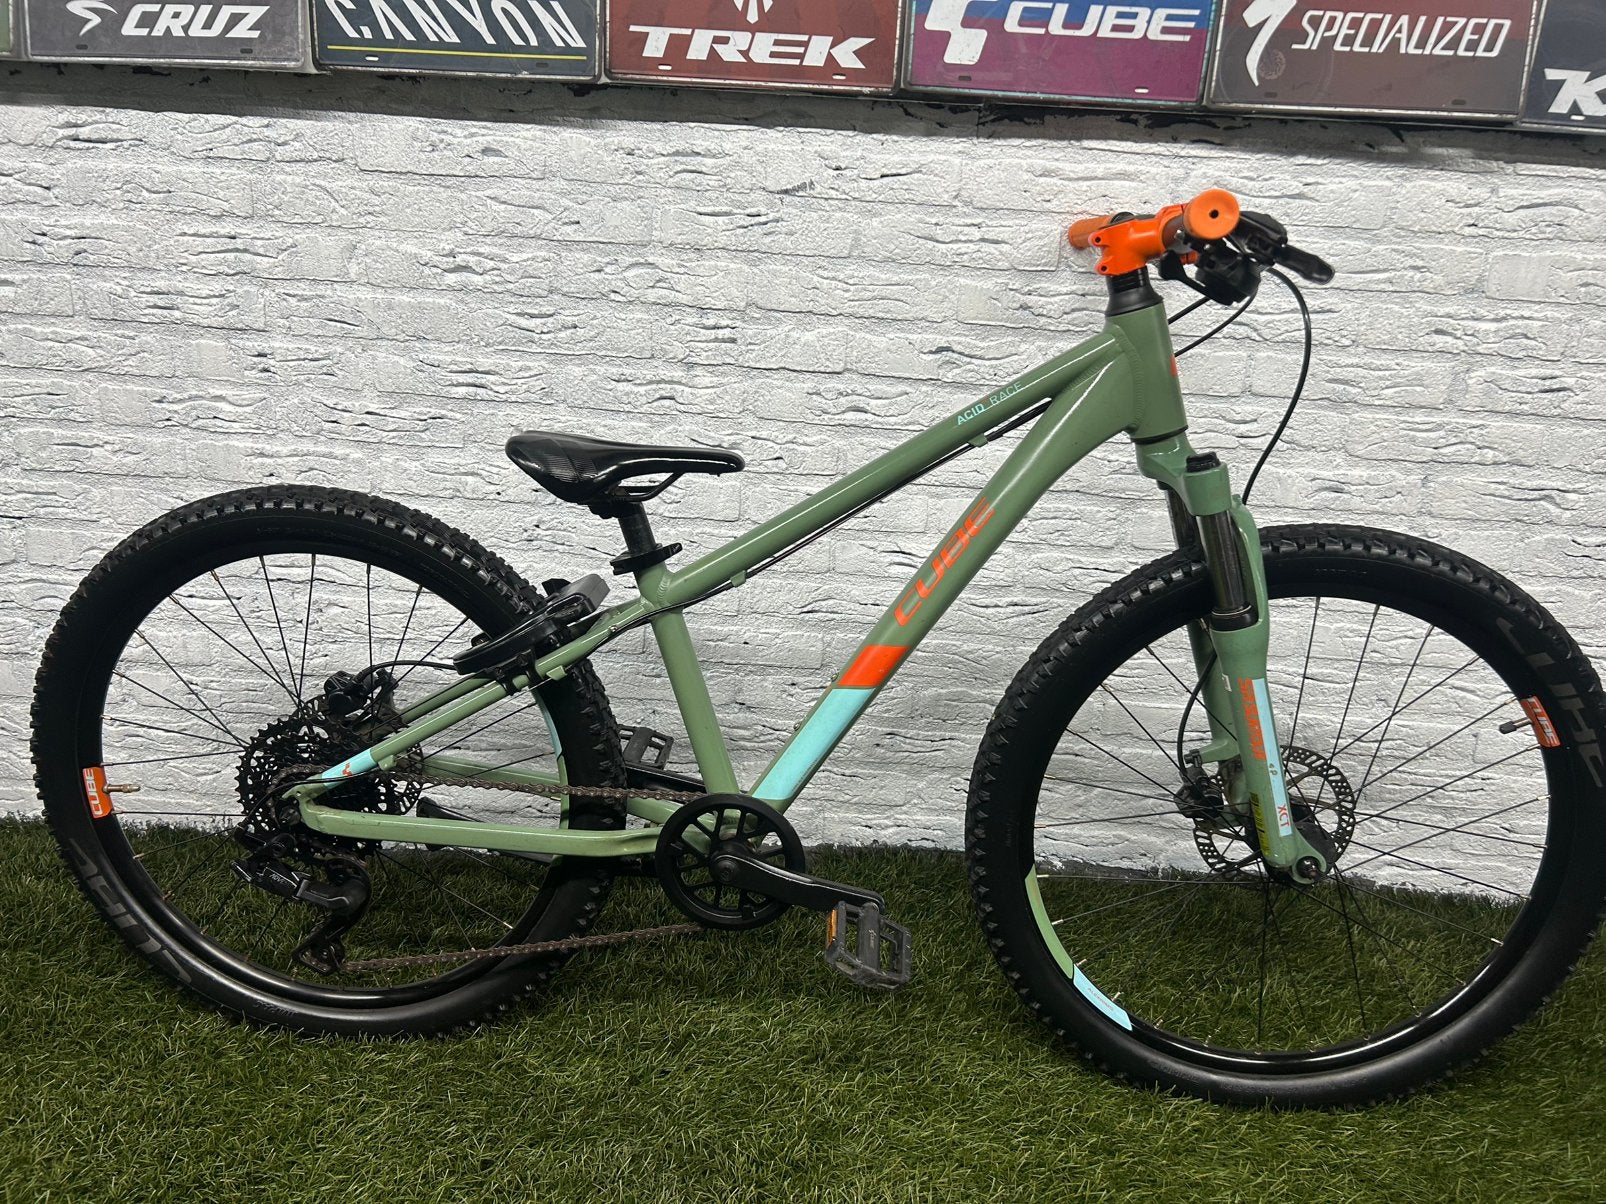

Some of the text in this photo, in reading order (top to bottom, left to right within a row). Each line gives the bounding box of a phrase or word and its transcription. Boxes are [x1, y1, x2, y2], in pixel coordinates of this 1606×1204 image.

[121, 3, 270, 38] CRUZ
[325, 0, 587, 48] CANYON
[1003, 1, 1200, 42] CUBE
[1291, 9, 1512, 58] SPECIALIZED
[629, 24, 876, 69] TREK
[1544, 68, 1606, 116] K
[957, 403, 985, 425] ACID
[894, 496, 996, 626] CUBE
[83, 768, 103, 816] CUBE
[1277, 803, 1291, 828] XCT
